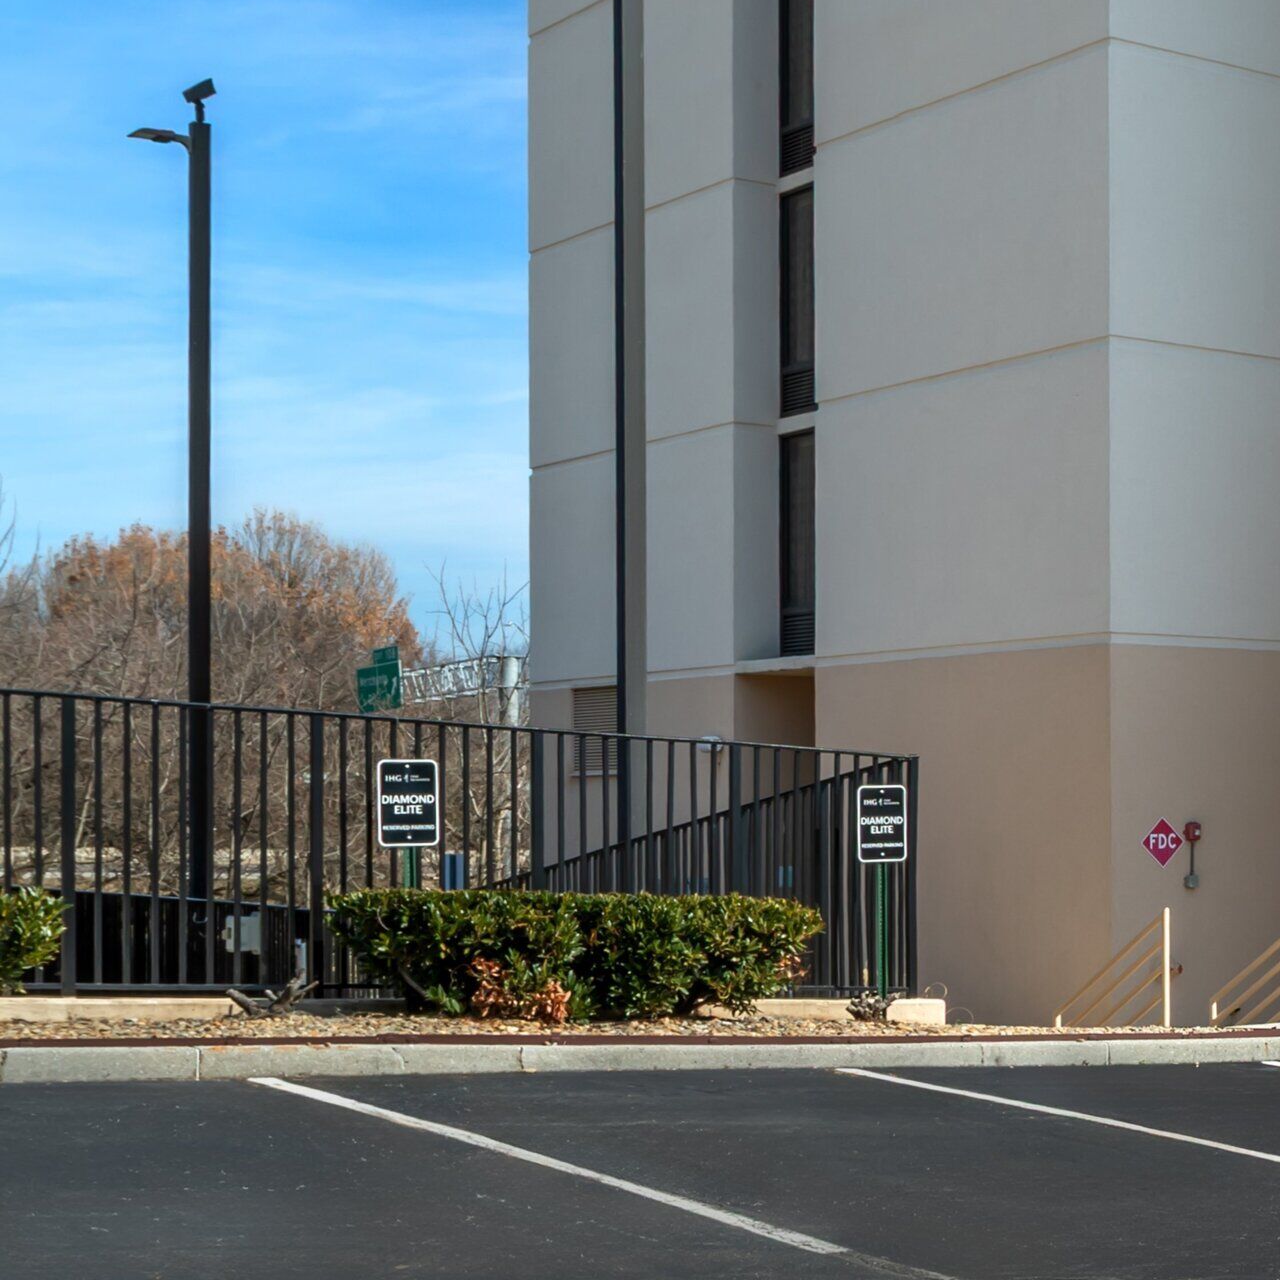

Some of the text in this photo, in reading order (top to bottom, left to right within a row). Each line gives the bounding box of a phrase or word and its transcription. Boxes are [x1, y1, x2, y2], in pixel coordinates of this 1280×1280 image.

[385, 774, 402, 782] IHG
[381, 794, 435, 805] DIAMOND
[393, 805, 423, 814] ELITE
[860, 816, 904, 825] DIAMOND
[870, 825, 894, 834] ELITE
[1149, 833, 1177, 849] FDC
